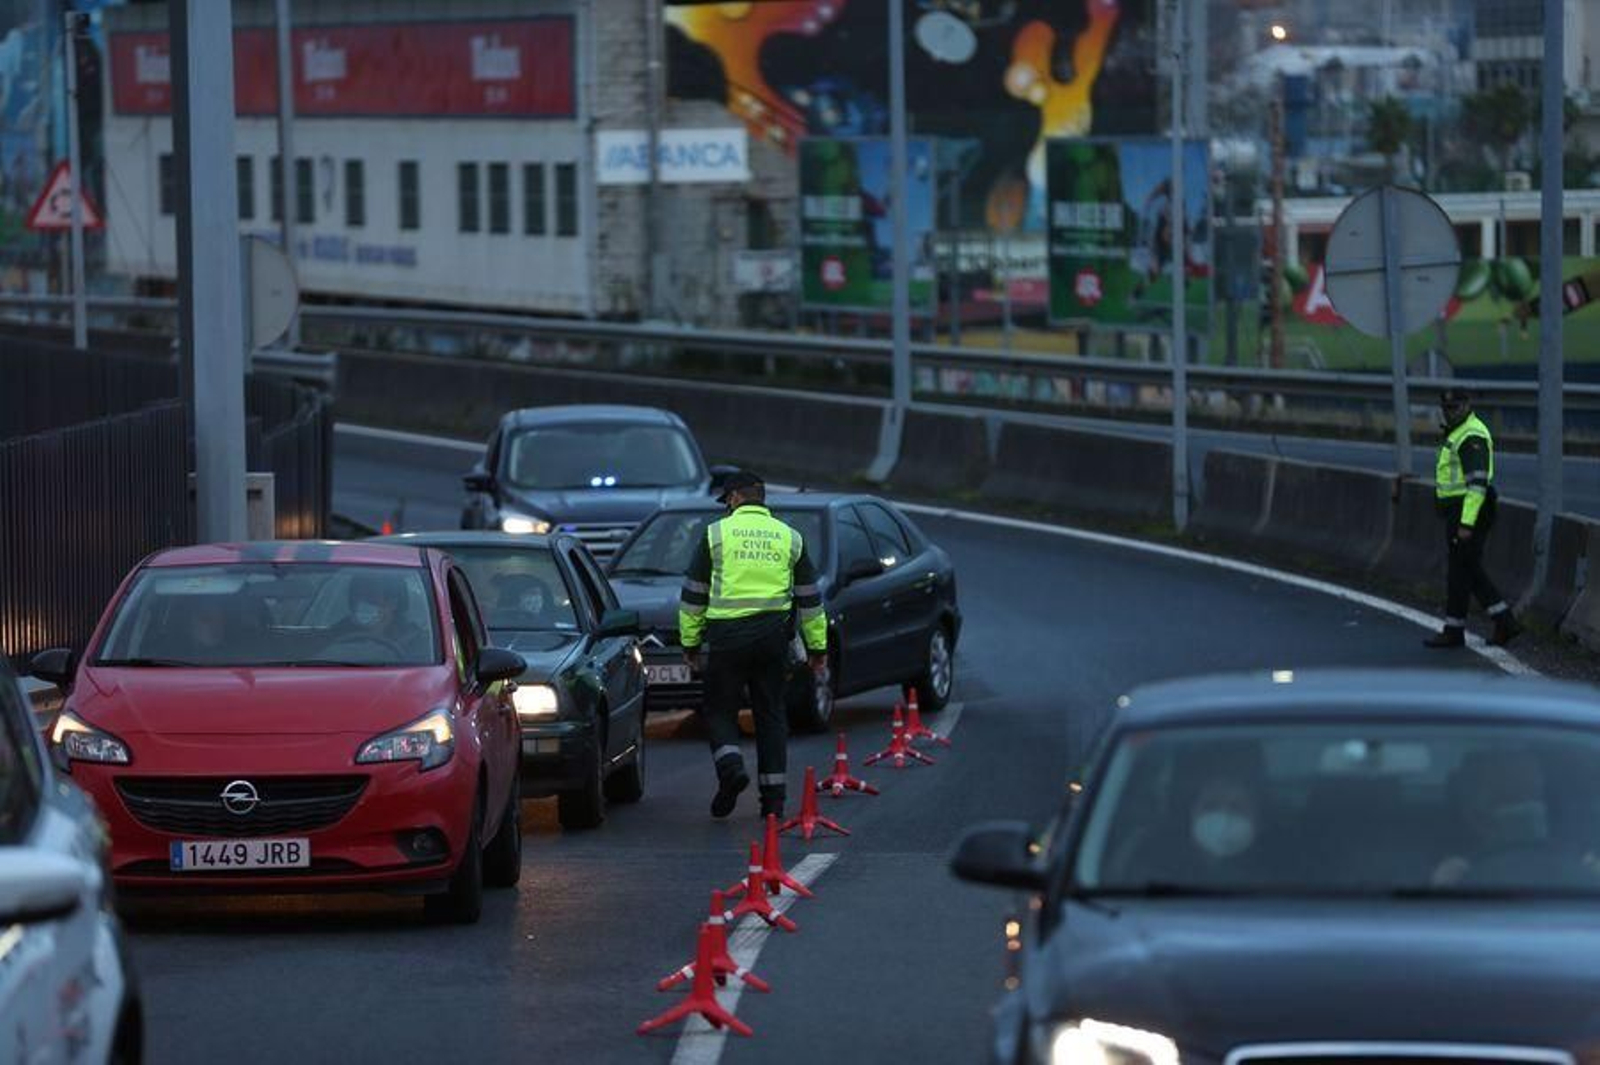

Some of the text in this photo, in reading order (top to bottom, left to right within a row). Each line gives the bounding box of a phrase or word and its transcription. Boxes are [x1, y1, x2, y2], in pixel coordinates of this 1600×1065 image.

[606, 142, 741, 169] ABANCA
[732, 528, 782, 540] GUARDIA
[743, 540, 774, 550] CIVIL
[189, 842, 300, 866] 1449 JRB
